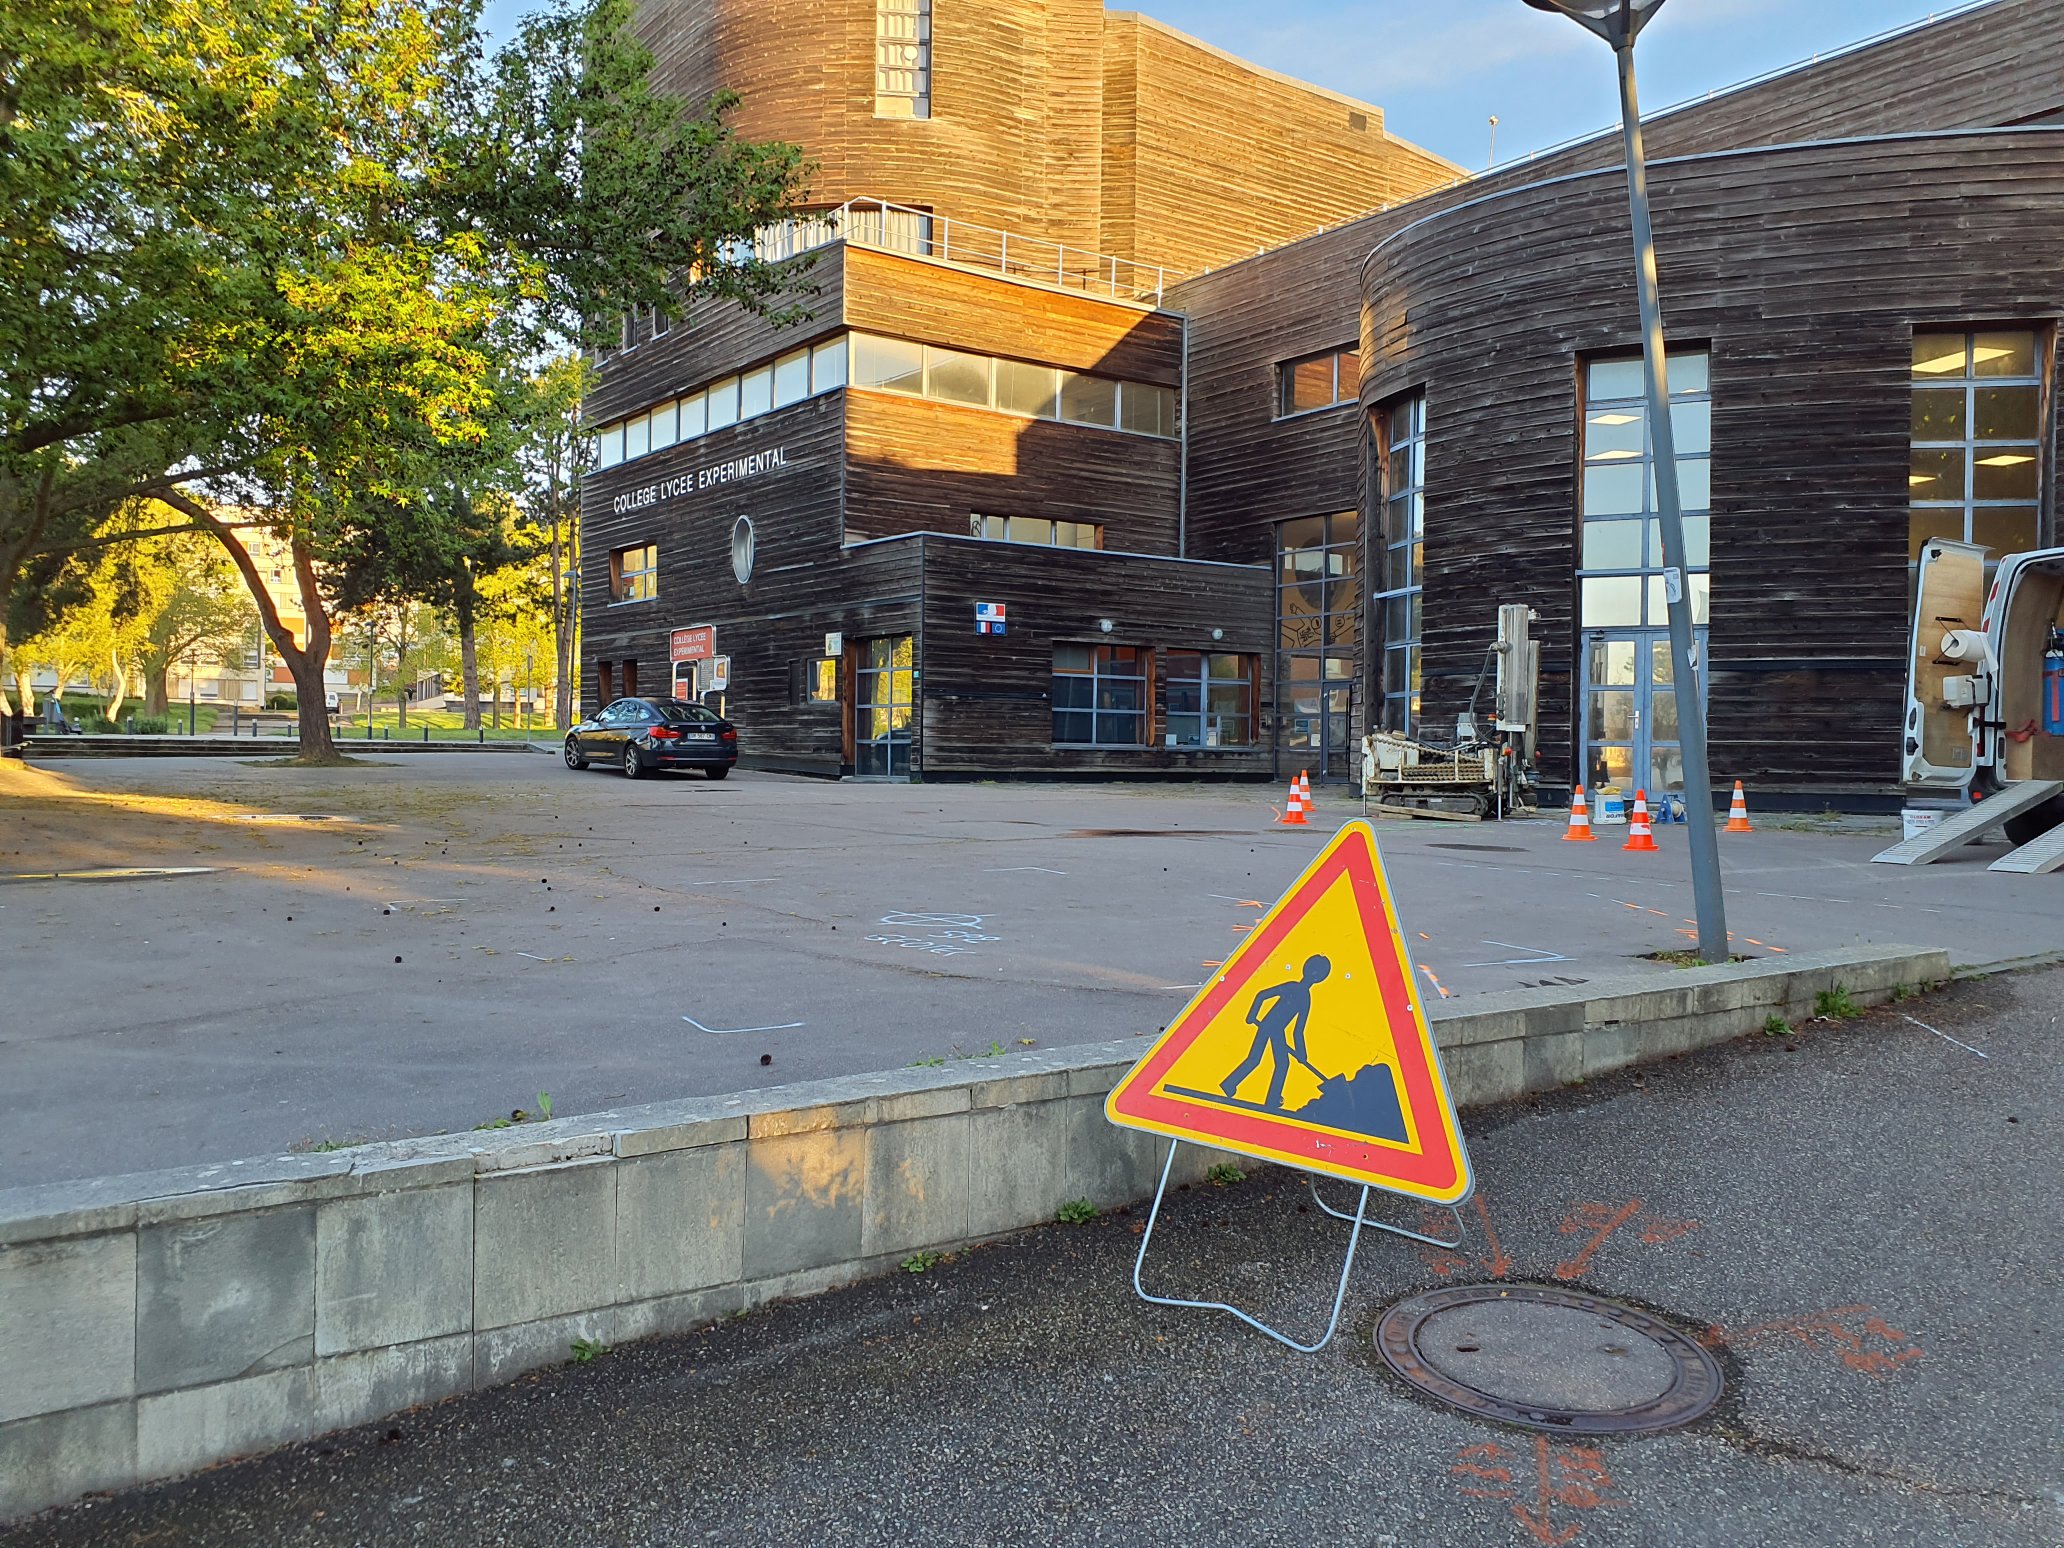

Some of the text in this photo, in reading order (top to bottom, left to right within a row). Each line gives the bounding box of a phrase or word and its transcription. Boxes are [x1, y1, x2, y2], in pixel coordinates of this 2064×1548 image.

[613, 446, 787, 513] COLLEGE LYCEE EXPERIMENTAL
